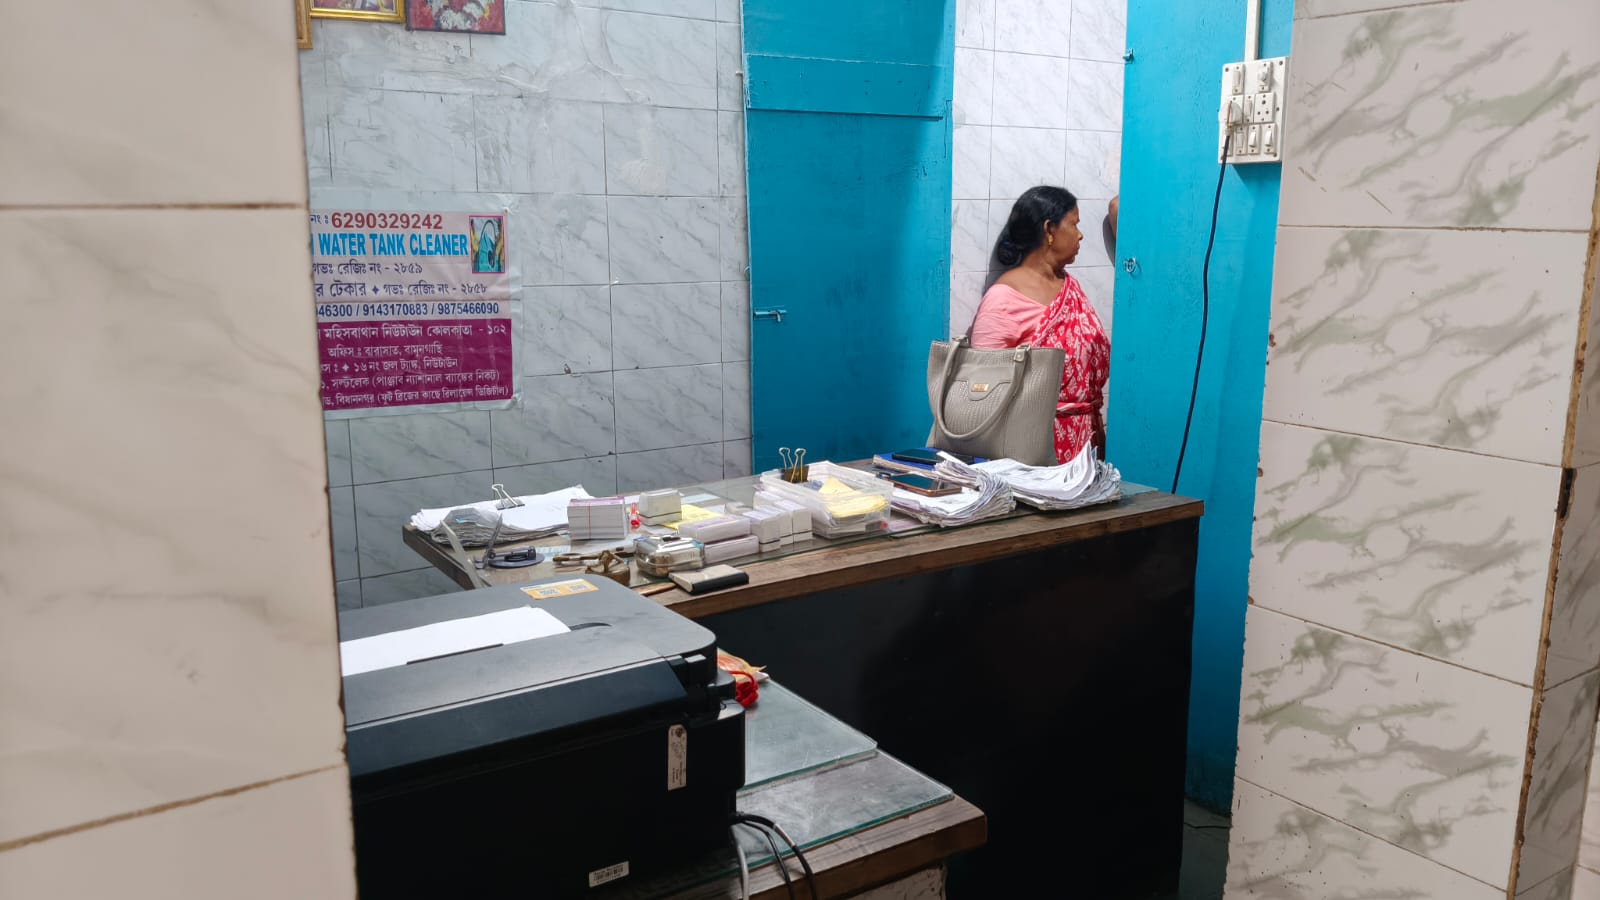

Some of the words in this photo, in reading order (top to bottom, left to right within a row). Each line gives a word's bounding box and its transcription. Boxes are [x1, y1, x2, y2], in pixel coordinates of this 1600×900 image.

[331, 212, 443, 229] 6290329242
[318, 233, 366, 256] WATER
[369, 233, 406, 256] TANK
[409, 233, 468, 256] CLEANER
[368, 263, 381, 275] নং
[330, 279, 366, 297] টেকার
[437, 283, 449, 295] নং
[316, 304, 353, 318] 46300
[356, 304, 360, 316] /
[363, 303, 428, 316] 9143170883
[431, 303, 435, 315] /
[437, 302, 499, 315] 9875466090
